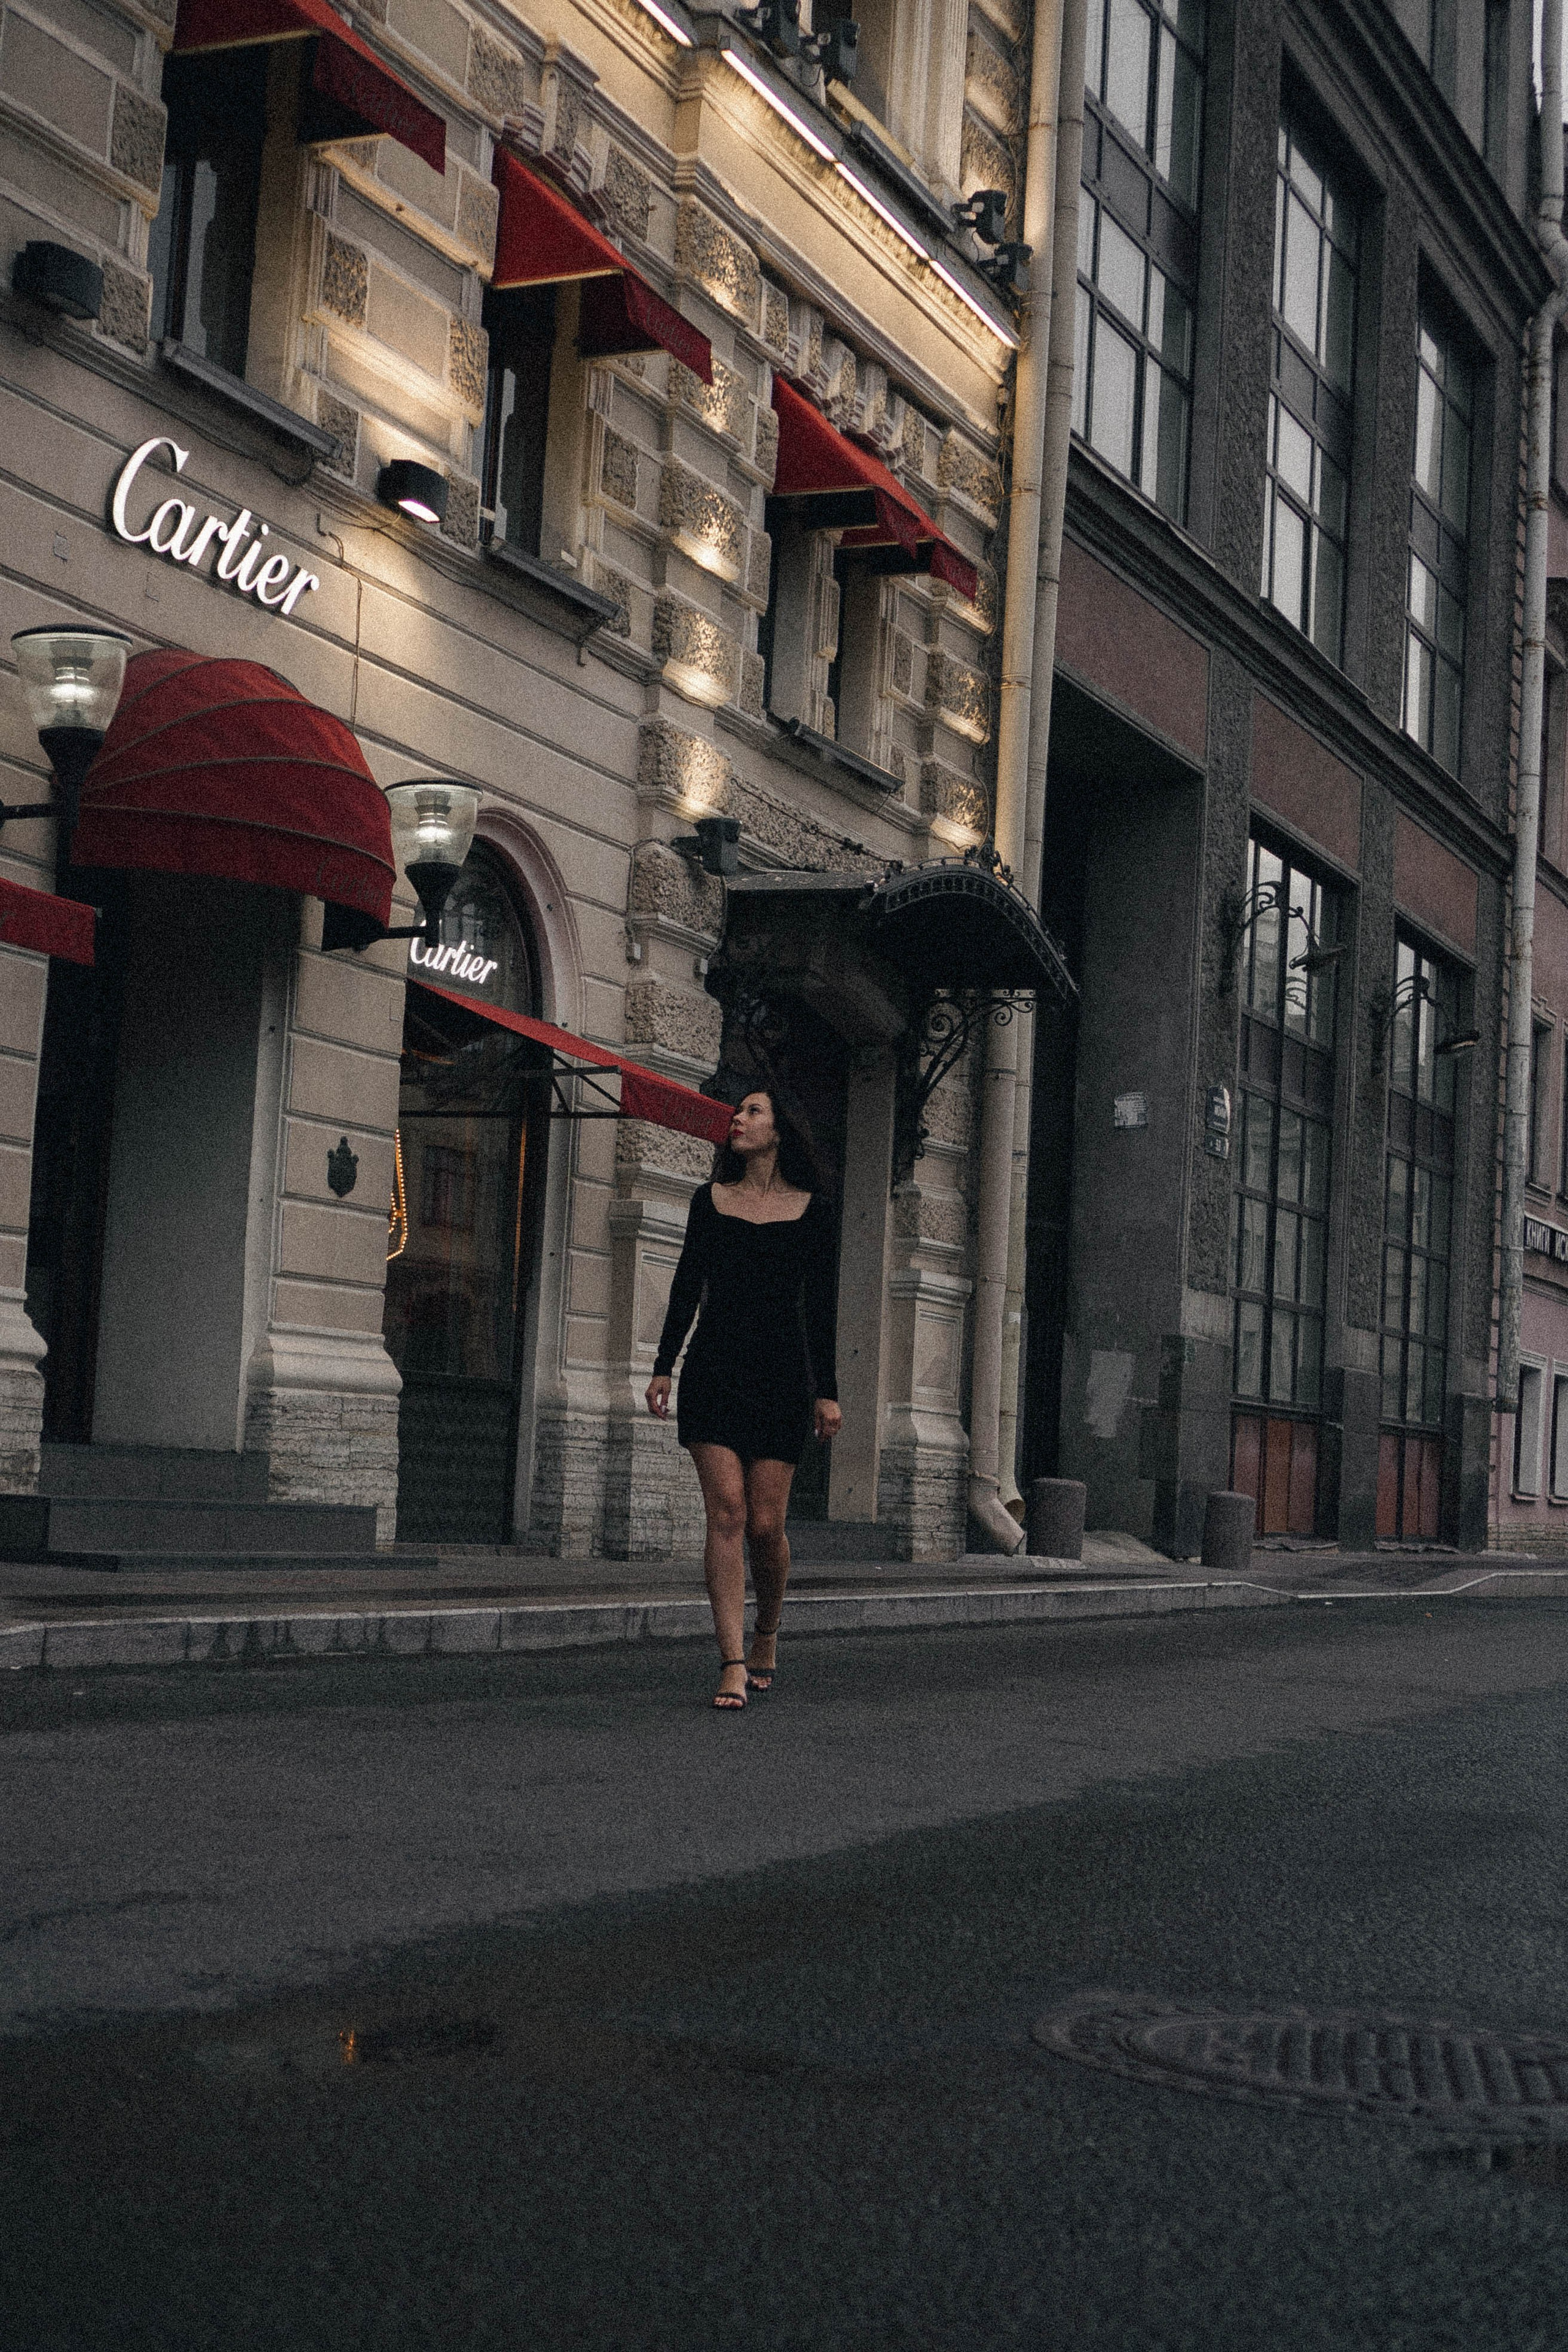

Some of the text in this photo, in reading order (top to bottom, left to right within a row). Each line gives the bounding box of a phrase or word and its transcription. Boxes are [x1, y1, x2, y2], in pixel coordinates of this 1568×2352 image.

[113, 437, 320, 615] Cartier
[410, 919, 497, 984] Cartier
[1526, 1218, 1550, 1254] КНИГИ
